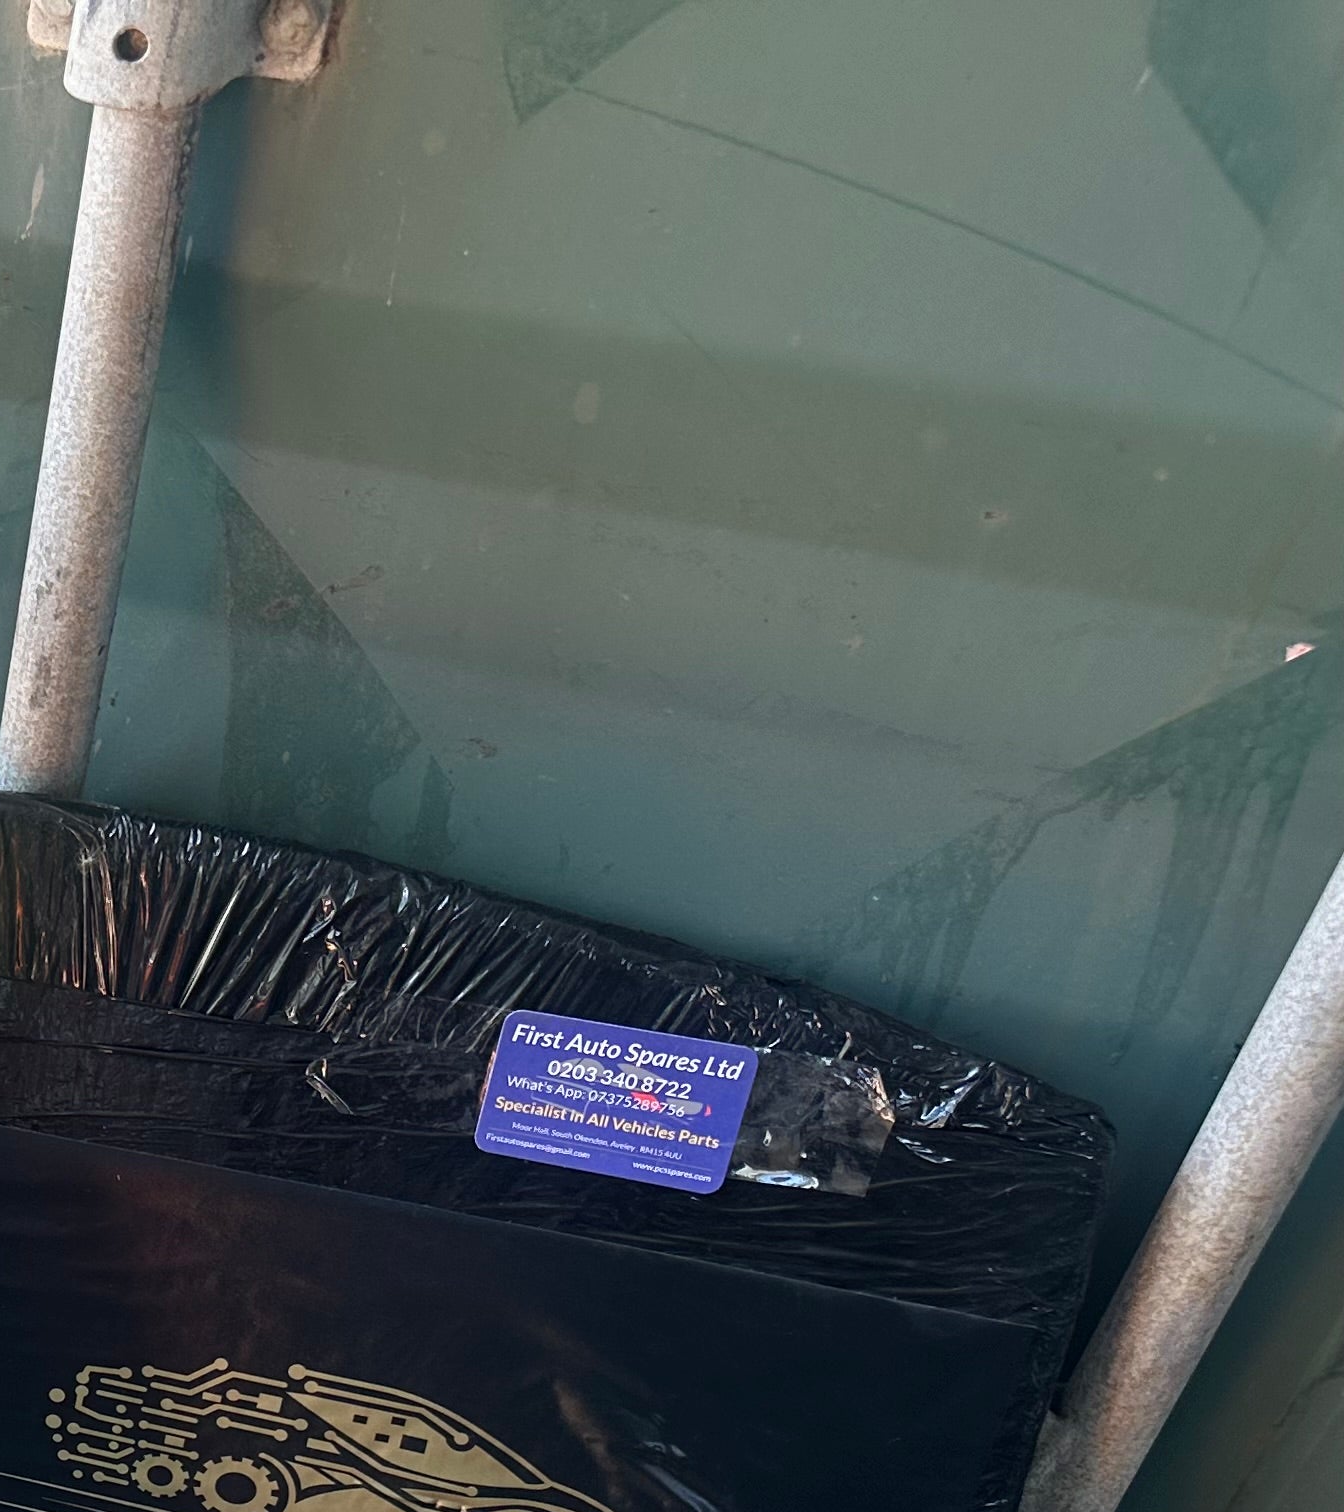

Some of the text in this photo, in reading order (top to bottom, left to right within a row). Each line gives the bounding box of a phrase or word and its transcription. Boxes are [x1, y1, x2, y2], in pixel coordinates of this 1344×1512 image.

[511, 1023, 745, 1081] First Auto Spares Ltd
[507, 1075, 685, 1118] What's App: 07375289756
[548, 1060, 692, 1100] 0203 340 8722
[494, 1096, 569, 1122] Specialist
[587, 1112, 609, 1128] All
[612, 1116, 675, 1141] Vehicles
[678, 1129, 720, 1150] Parts
